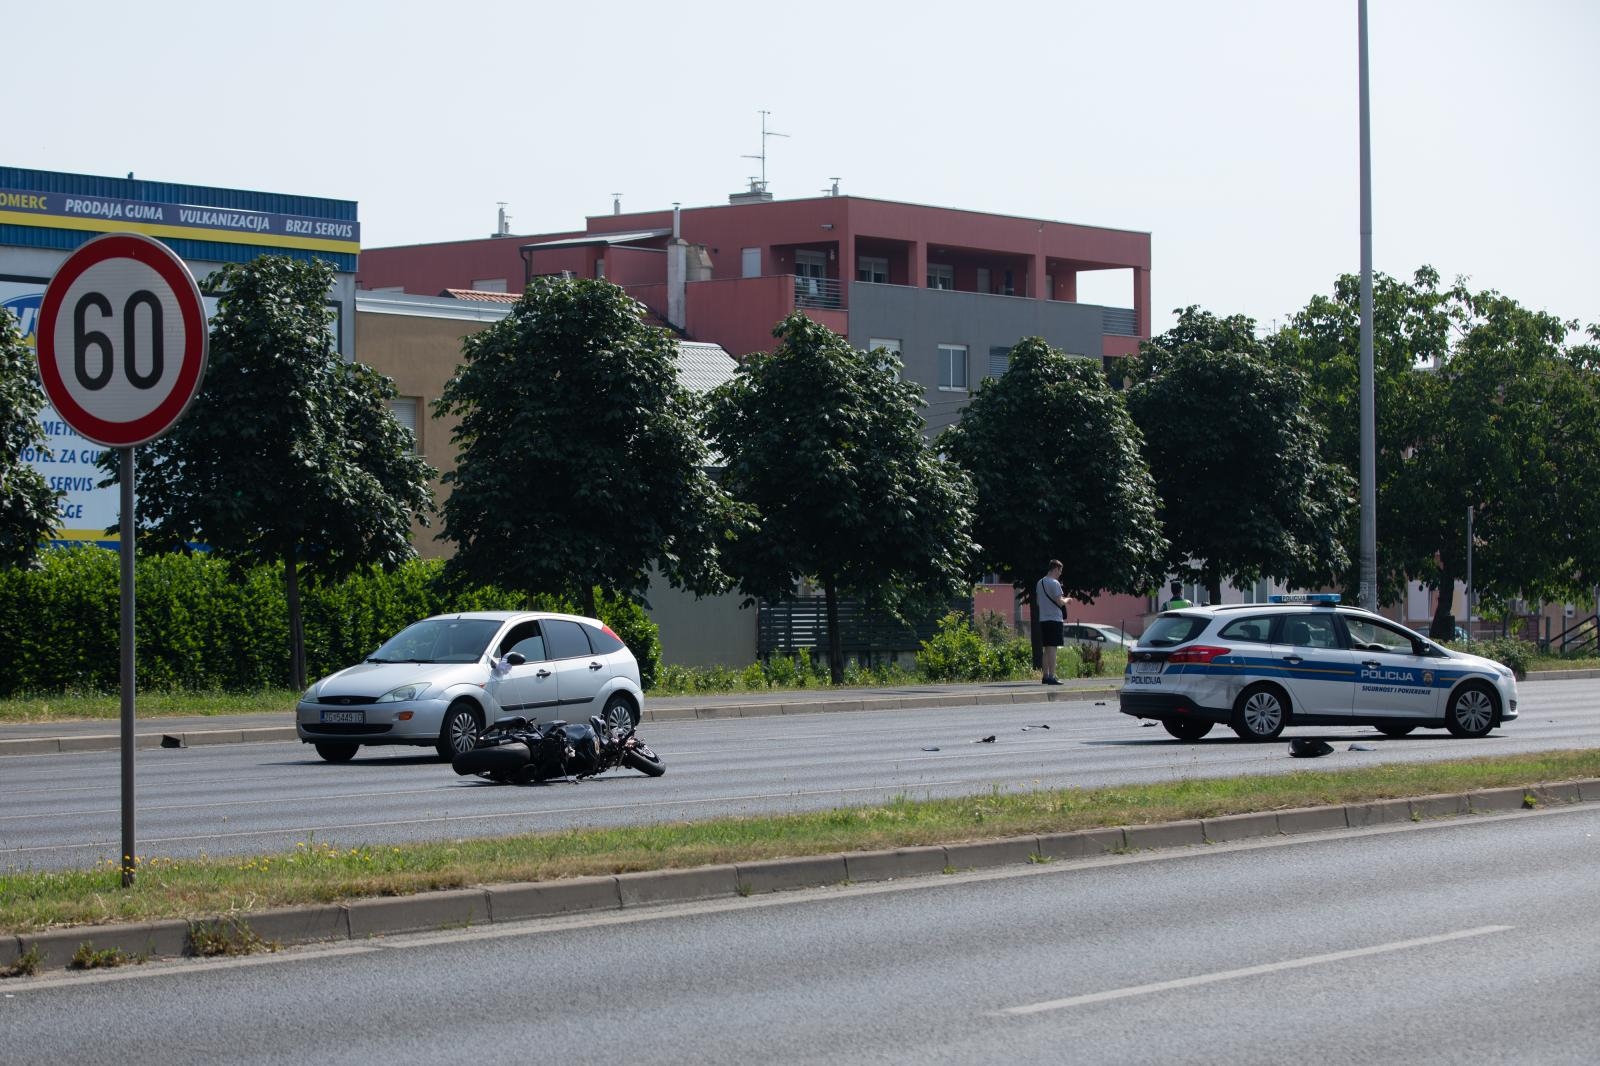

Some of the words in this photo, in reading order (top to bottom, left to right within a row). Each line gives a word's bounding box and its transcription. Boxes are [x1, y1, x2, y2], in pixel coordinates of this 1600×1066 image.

[64, 199, 122, 219] PRODAJA
[125, 204, 164, 221] GUMA
[179, 209, 270, 232] VULKANIZACIJA
[285, 219, 312, 234] BRZI
[314, 222, 353, 238] SERVIS
[73, 290, 164, 391] 60
[59, 449, 76, 464] ZA
[49, 476, 94, 492] SERVIS
[1131, 675, 1162, 685] POLICIJA
[1361, 669, 1415, 682] POLICIJA
[1362, 685, 1393, 693] SIGURNOST
